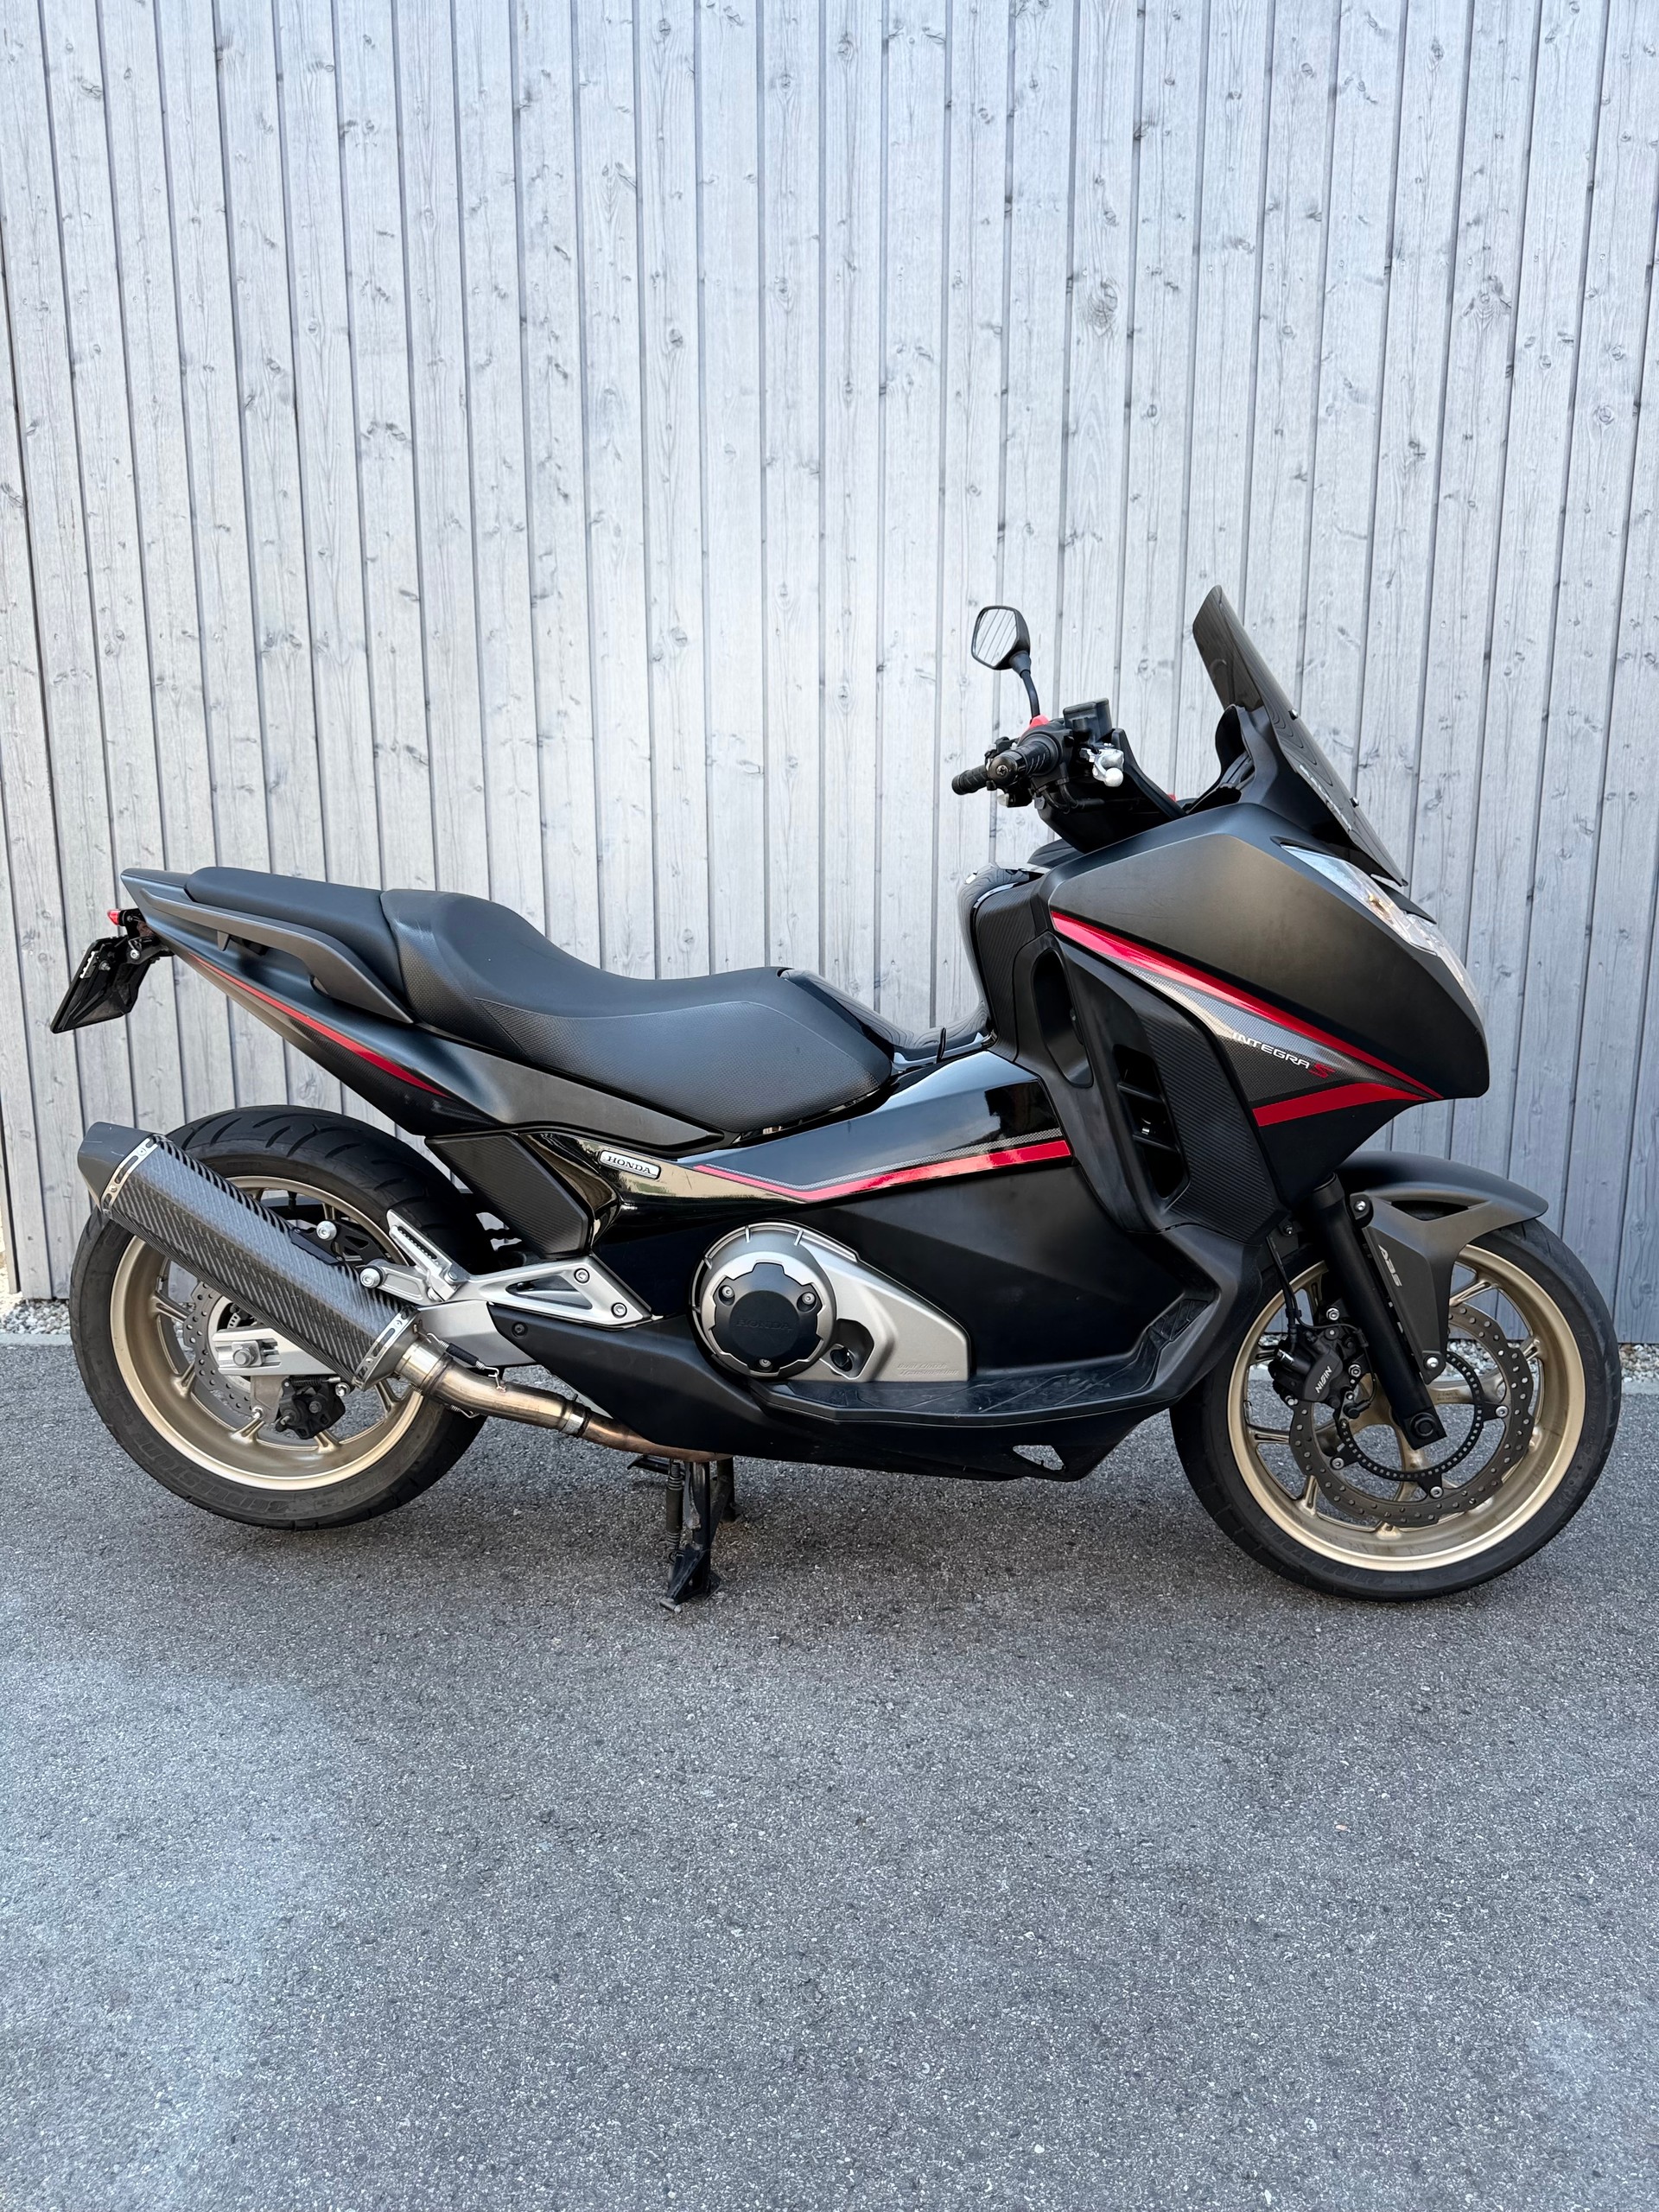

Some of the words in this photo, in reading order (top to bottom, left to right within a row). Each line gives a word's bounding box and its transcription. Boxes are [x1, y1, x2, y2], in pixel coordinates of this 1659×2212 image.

[1232, 1032, 1311, 1070] INTEGRA
[607, 1155, 652, 1174] HONDA
[1377, 1244, 1402, 1287] ABS
[735, 1319, 793, 1331] HONDA
